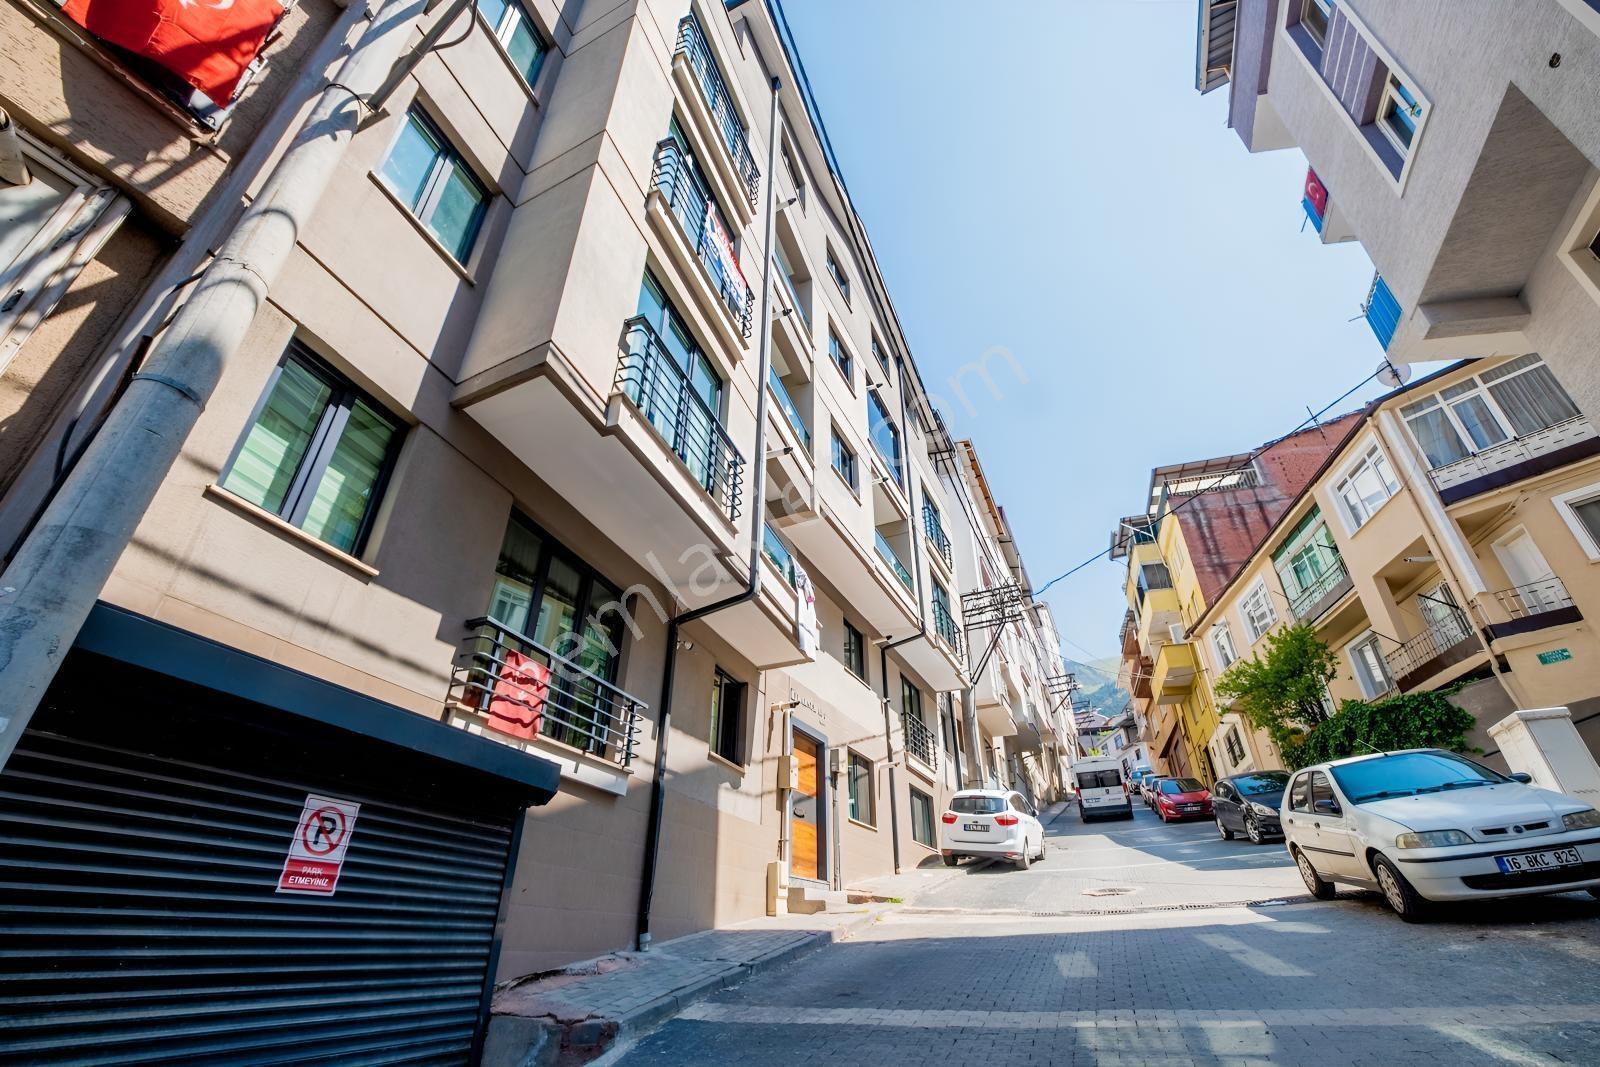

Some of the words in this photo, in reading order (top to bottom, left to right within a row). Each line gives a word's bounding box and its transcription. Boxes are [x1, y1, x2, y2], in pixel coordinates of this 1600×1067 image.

[1506, 858, 1521, 870] 16
[1525, 853, 1549, 868] BKC
[1554, 850, 1578, 863] 825
[302, 866, 323, 875] PARK
